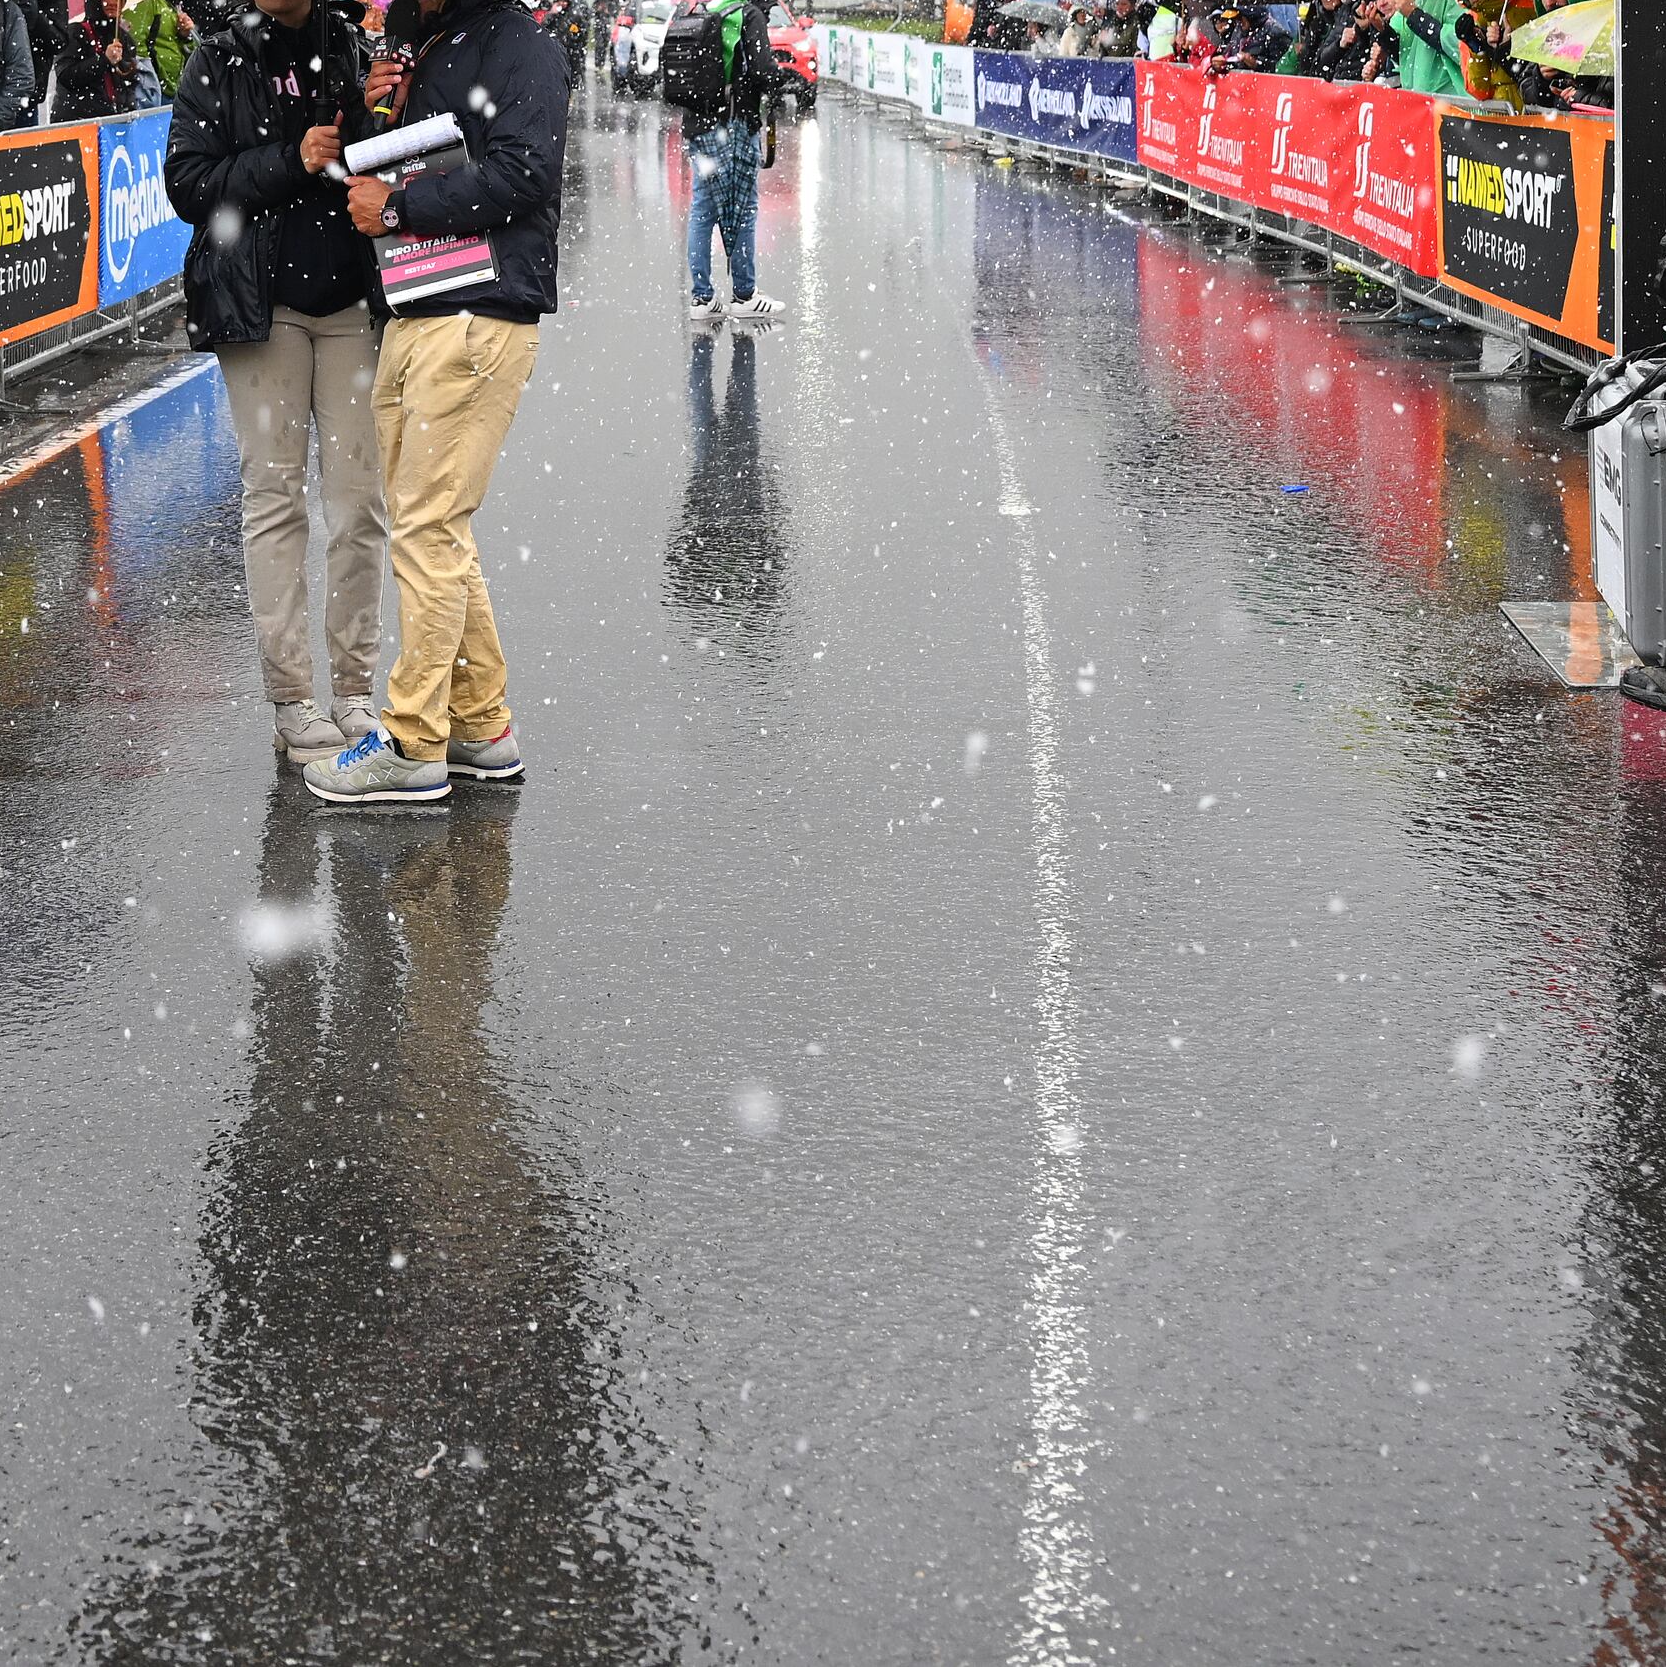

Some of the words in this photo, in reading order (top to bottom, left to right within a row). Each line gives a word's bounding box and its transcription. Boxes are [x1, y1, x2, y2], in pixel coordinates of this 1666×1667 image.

[1209, 135, 1243, 166] TRENITALIA
[1288, 152, 1329, 188] TRENITALIA
[1369, 172, 1415, 220] TRENITALIA
[393, 248, 431, 264] AMORE
[432, 235, 480, 254] INFINITO
[1466, 226, 1526, 271] SUPERFOOD
